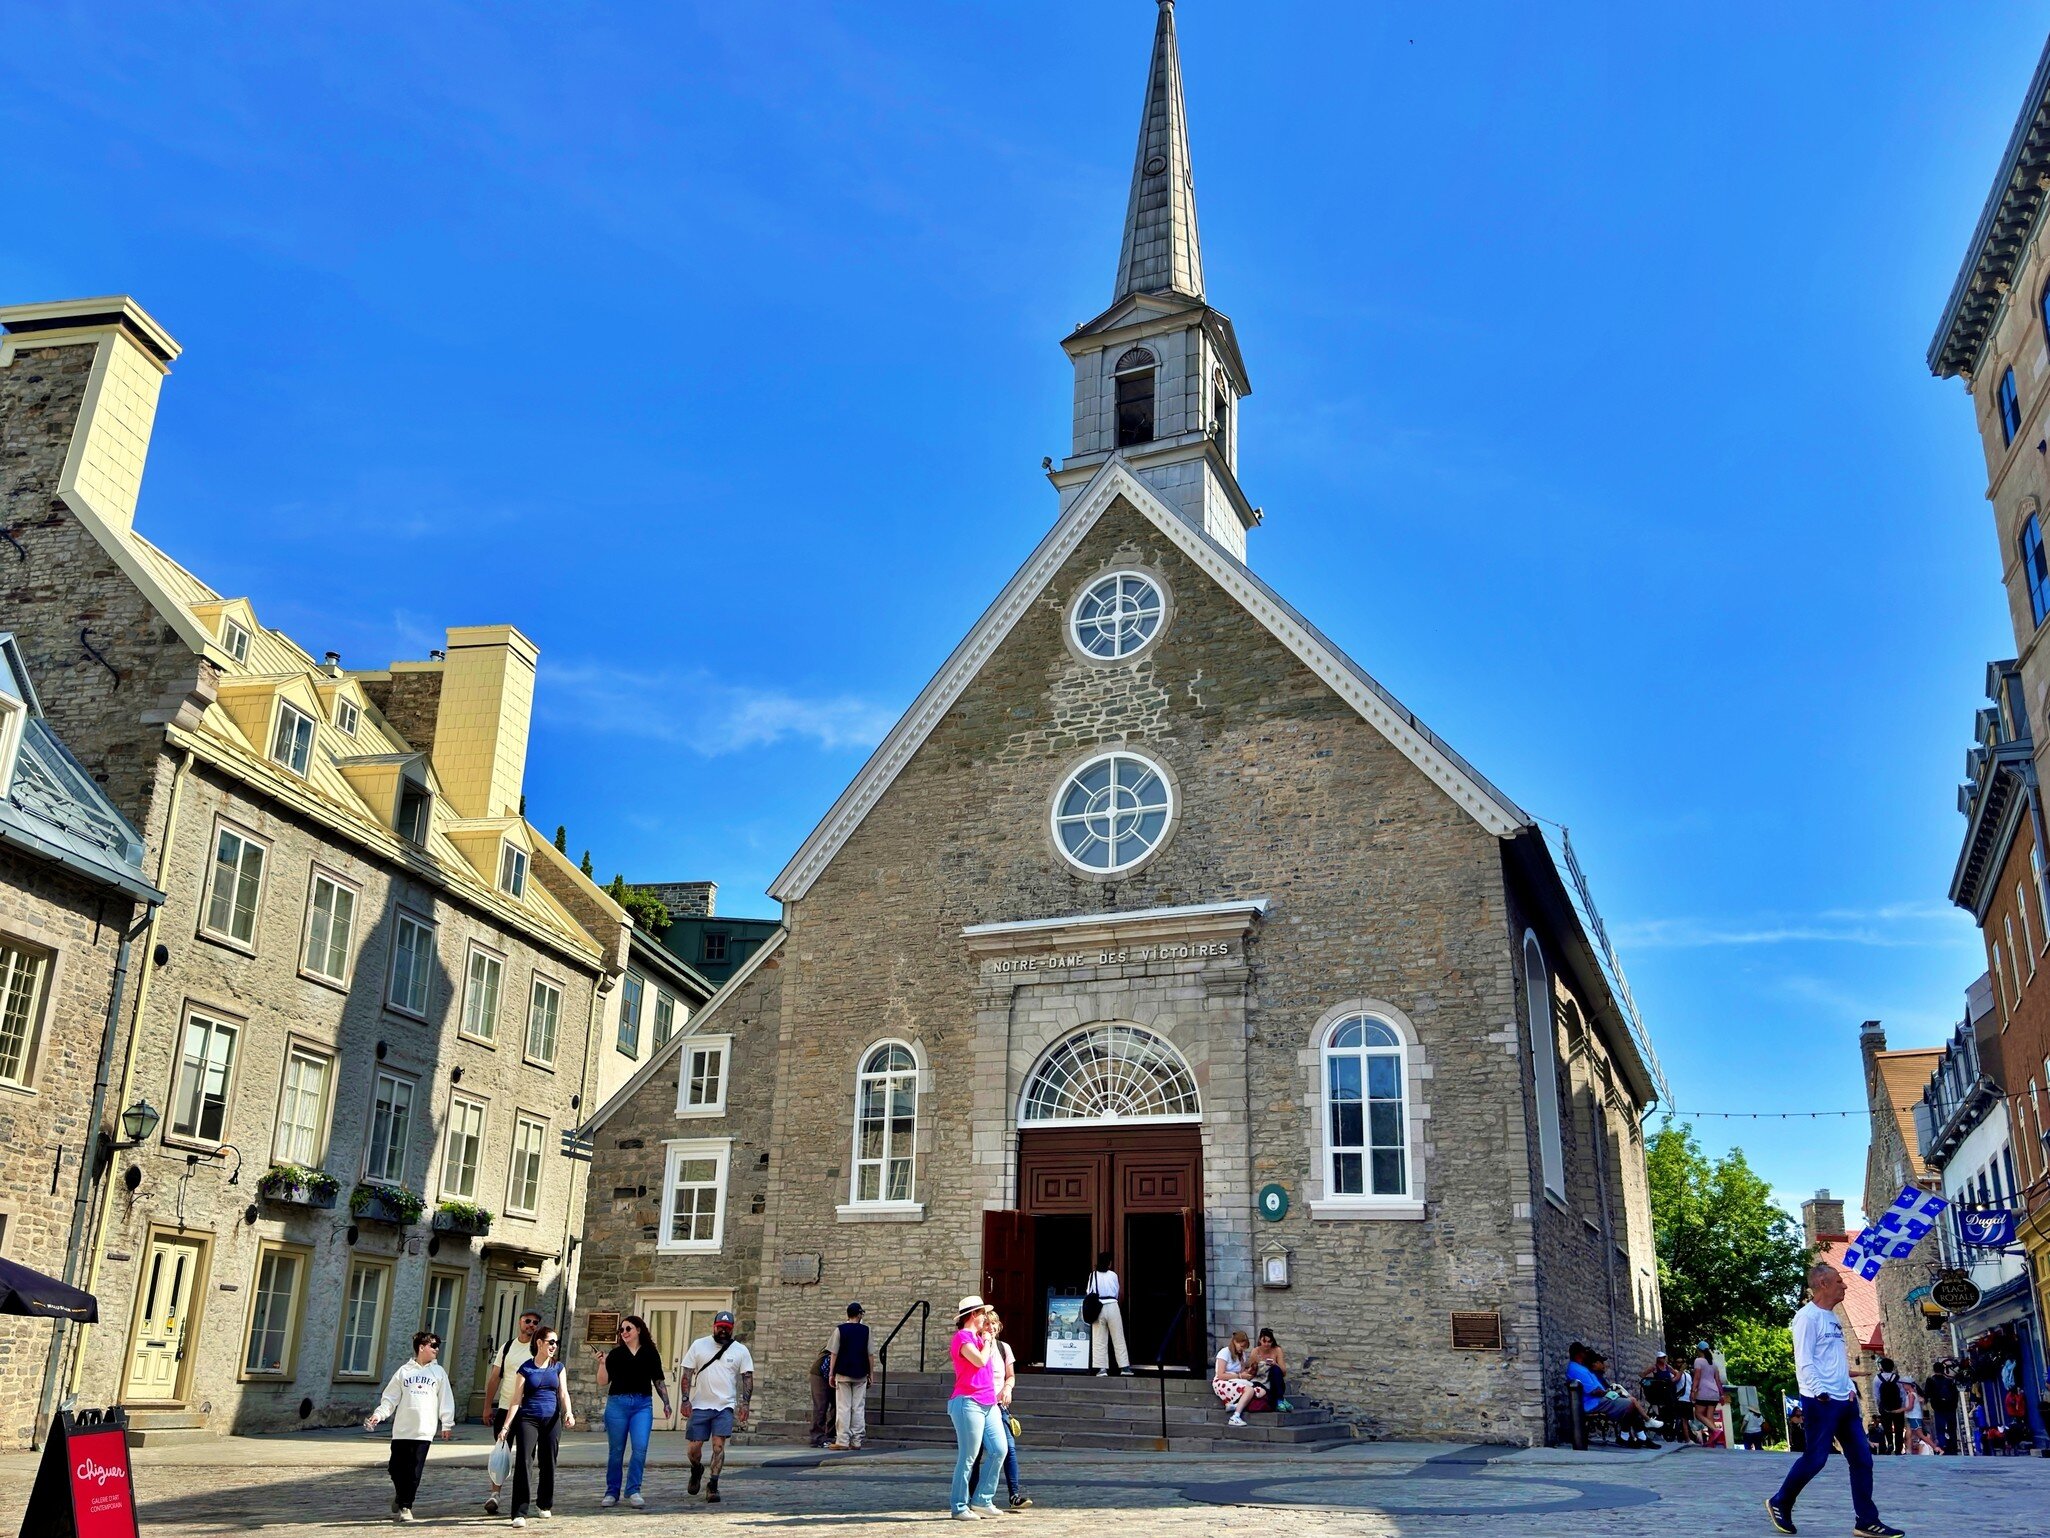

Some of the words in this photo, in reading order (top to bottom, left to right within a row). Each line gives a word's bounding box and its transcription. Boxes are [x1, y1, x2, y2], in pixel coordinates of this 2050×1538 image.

[993, 955, 1085, 973] NOTRE-DAME
[1099, 952, 1126, 964] DES
[1142, 943, 1229, 961] VICTOIRES
[1965, 1213, 2007, 1229] Dugal
[77, 1458, 125, 1486] Chiguer
